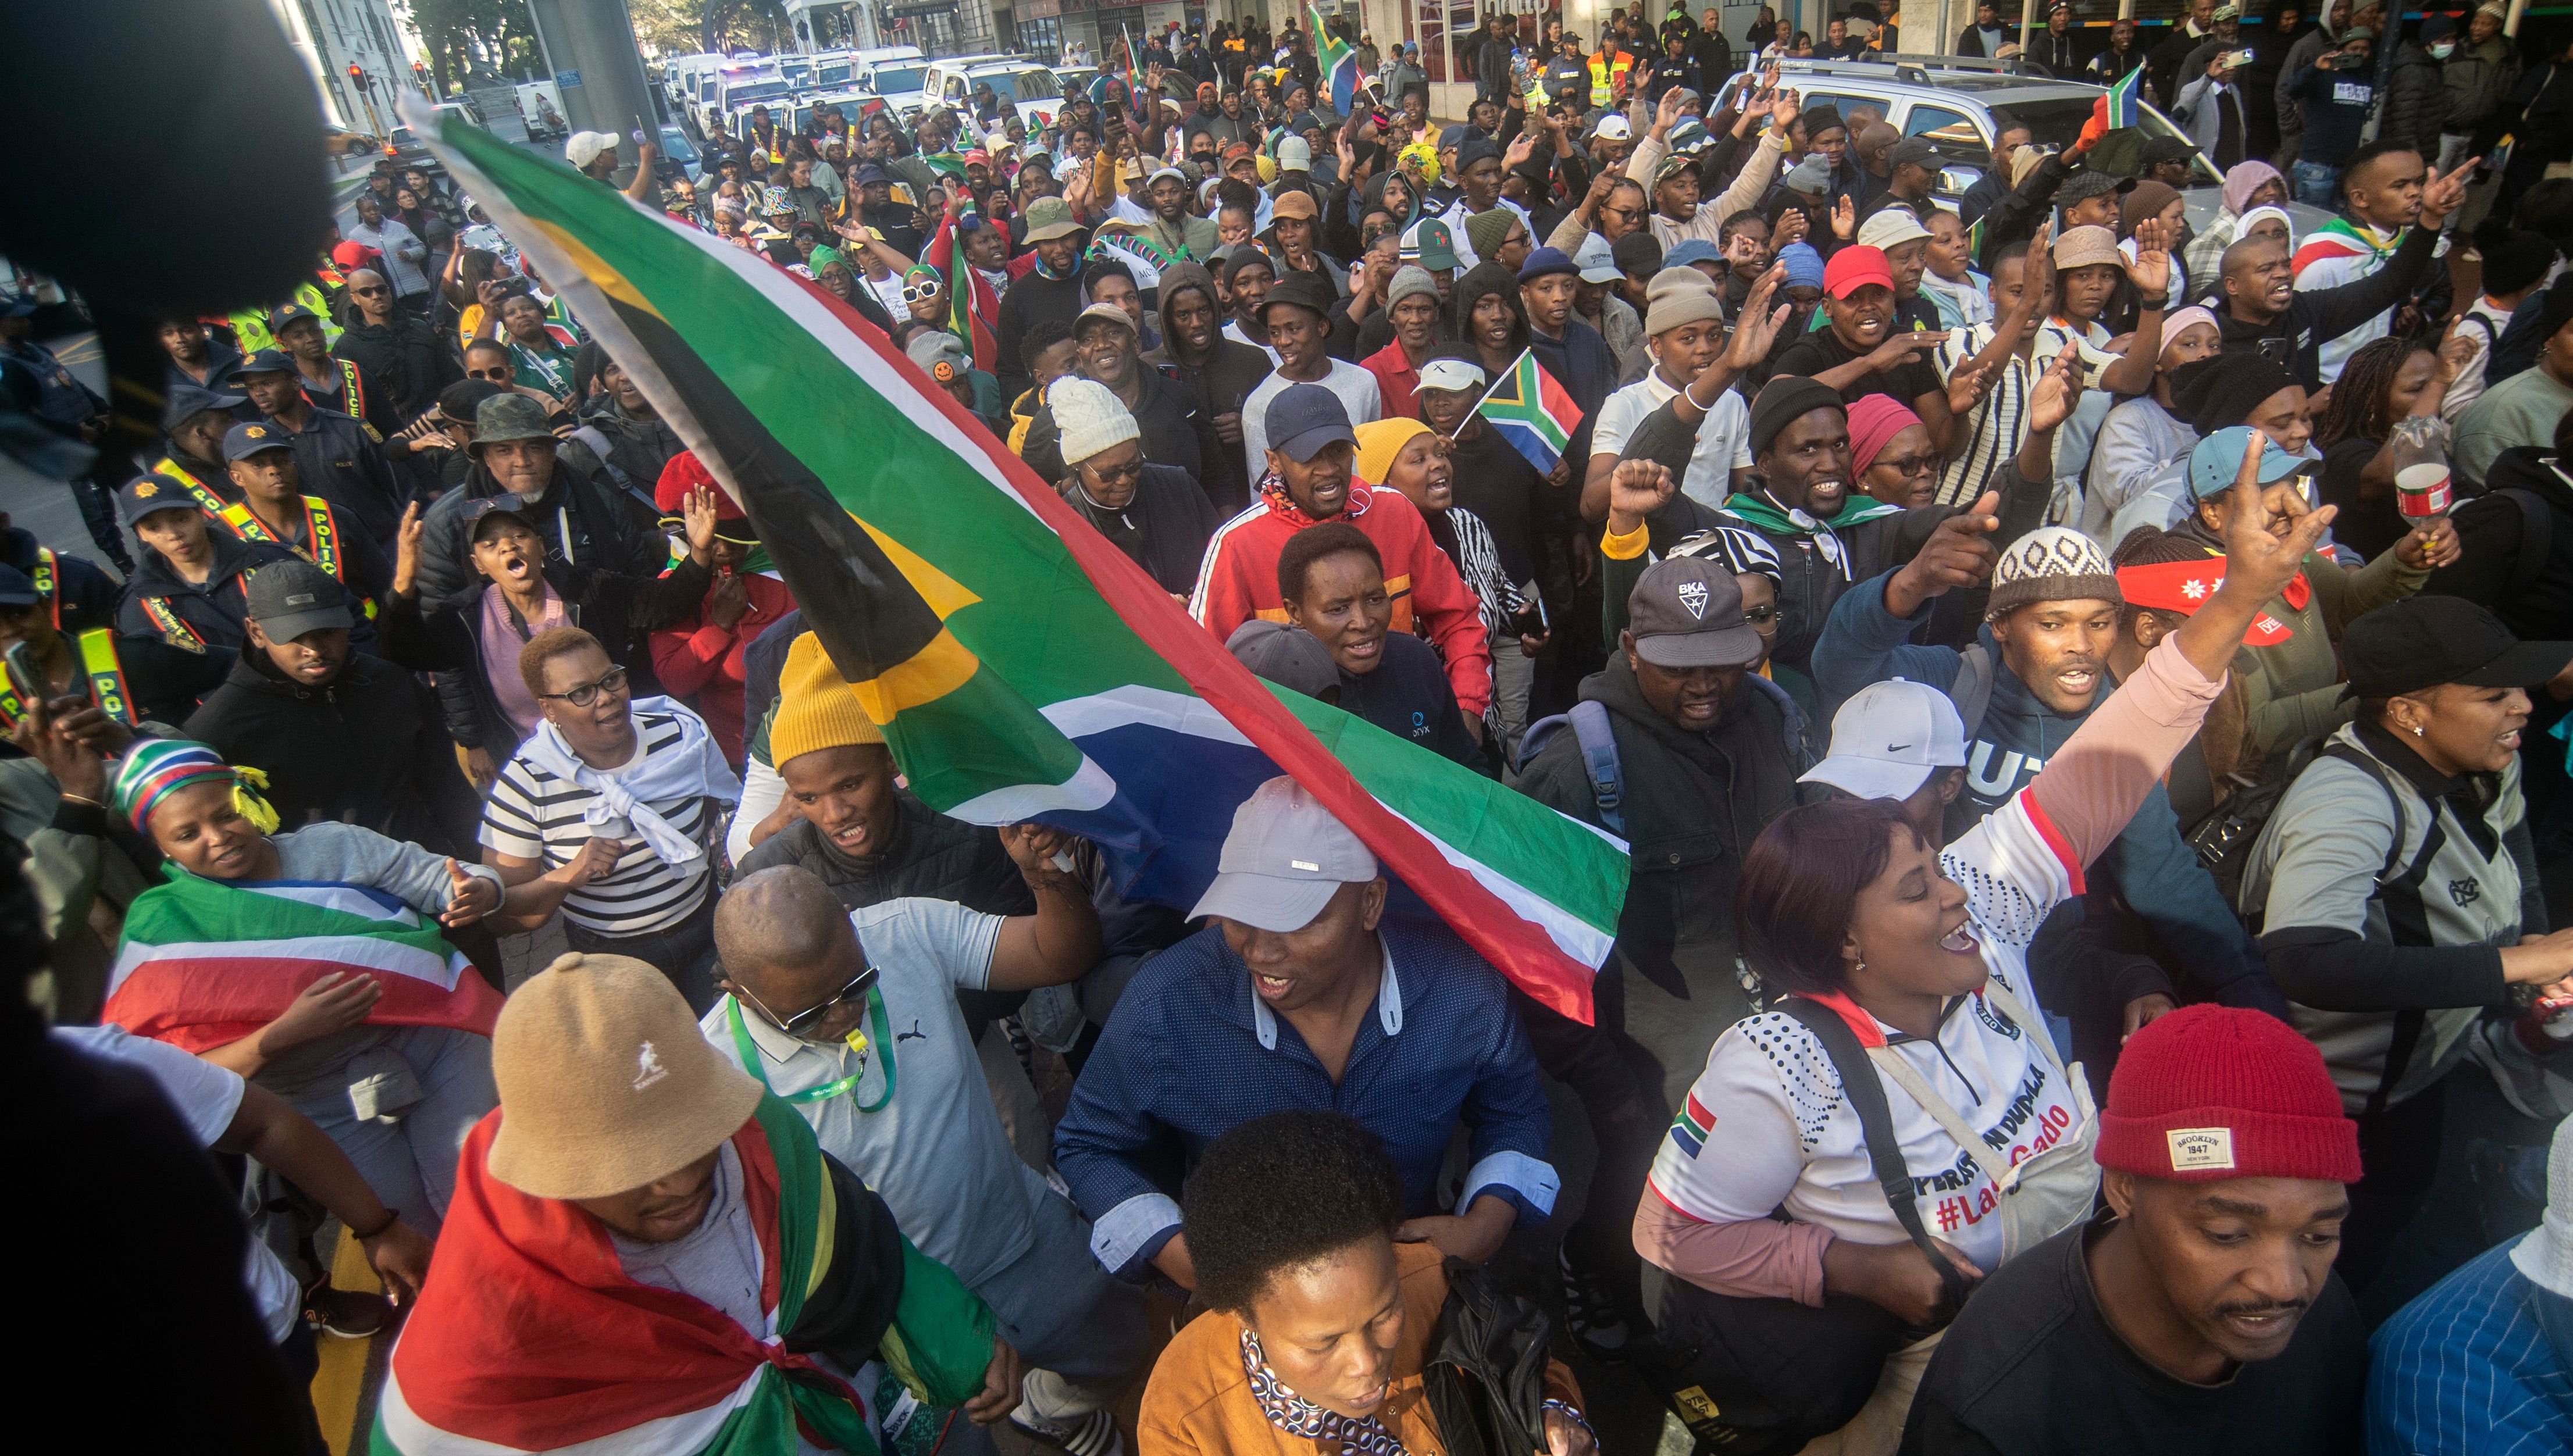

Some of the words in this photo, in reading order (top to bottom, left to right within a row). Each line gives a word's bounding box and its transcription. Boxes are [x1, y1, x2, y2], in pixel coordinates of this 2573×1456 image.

[344, 363, 359, 418] POLICE
[314, 513, 336, 575] POLIC
[1678, 581, 1707, 594] BKA
[1413, 726, 1430, 737] oryx
[2177, 1135, 2219, 1148] BROOKLYN
[2187, 1145, 2208, 1154] 1947
